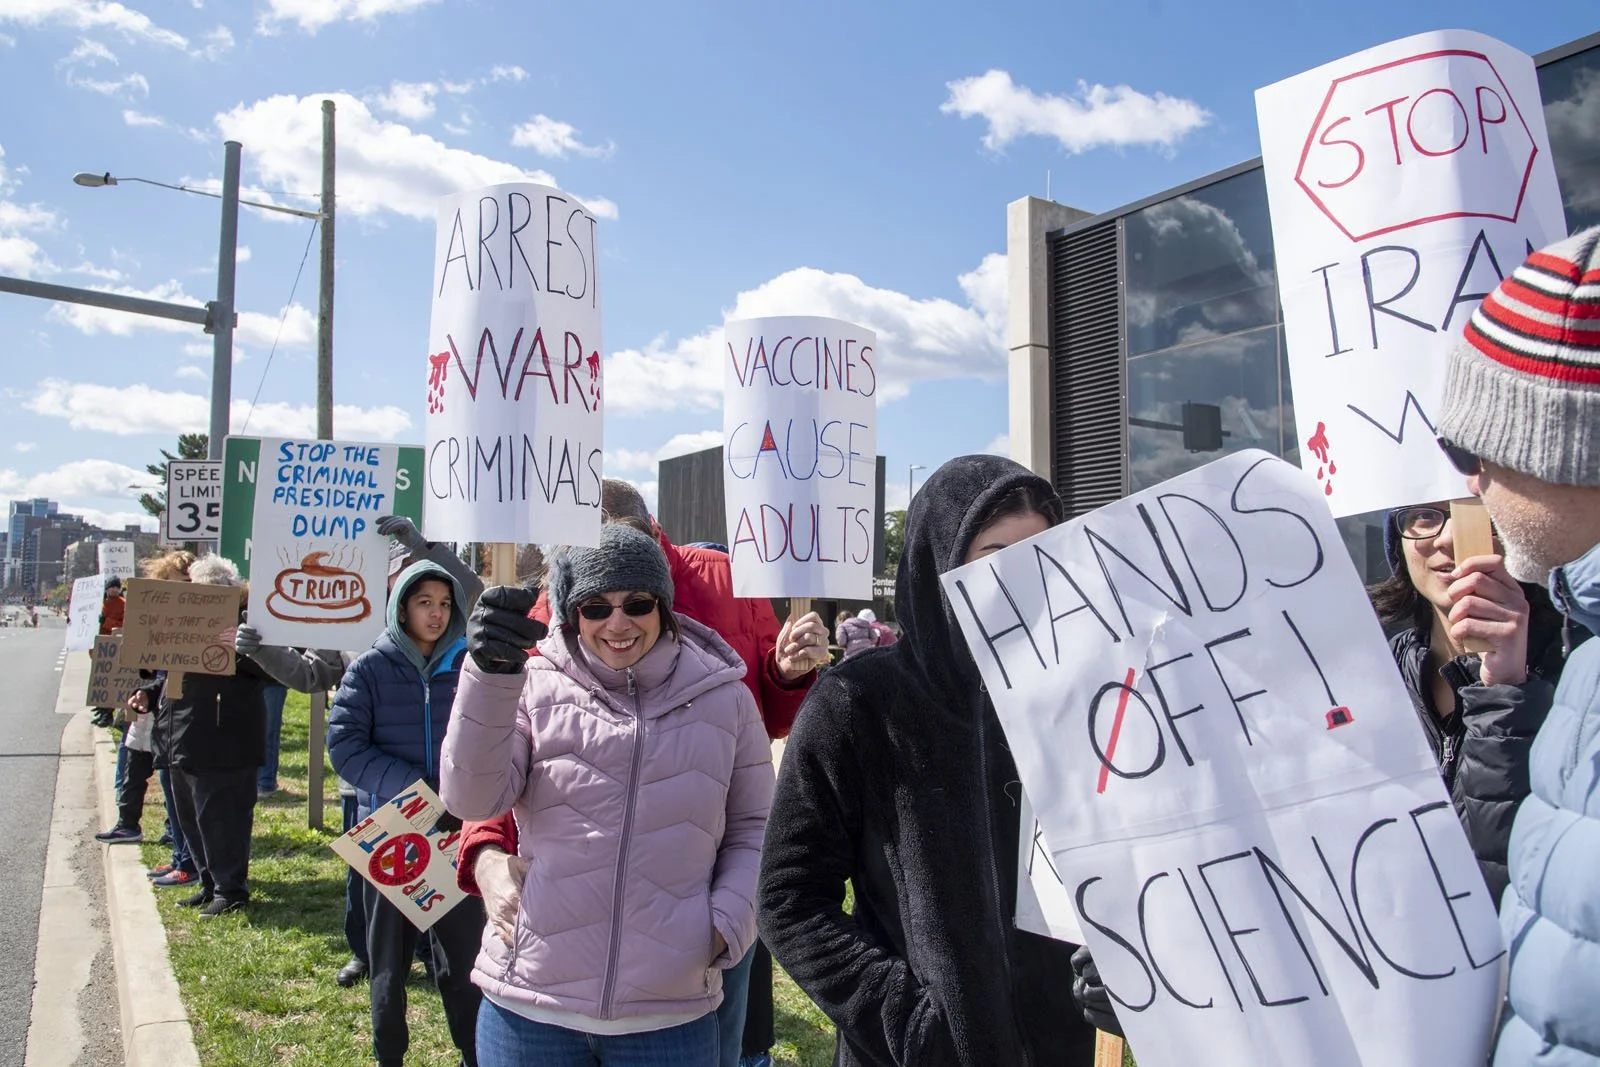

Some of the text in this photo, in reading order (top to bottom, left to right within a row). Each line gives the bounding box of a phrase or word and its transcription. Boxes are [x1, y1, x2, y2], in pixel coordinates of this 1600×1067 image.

[1317, 85, 1507, 188] STOP
[438, 192, 597, 309] ARREST
[1312, 229, 1536, 358] IRA
[447, 327, 590, 413] WAR
[727, 336, 876, 397] VACCINES
[277, 441, 380, 466] STOP THE
[728, 419, 868, 486] CAUSE
[174, 468, 220, 481] SPEE
[277, 464, 379, 489] CRIMINAL
[429, 433, 602, 508] CRIMINALS
[273, 486, 385, 511] PRESIDENT
[292, 514, 366, 540] DUMP
[731, 503, 870, 564] ADULTS
[956, 457, 1324, 689] HANDS
[140, 590, 172, 604] THE
[289, 579, 360, 600] TRUMP
[163, 615, 174, 627] IS
[177, 615, 205, 627] THAT
[207, 616, 225, 628] OF
[97, 642, 117, 658] NO
[139, 652, 200, 666] NO KINGS
[94, 660, 113, 674] NO
[93, 676, 109, 688] NO
[91, 689, 109, 703] NO
[347, 817, 389, 854] THE
[402, 878, 446, 912] STOP
[1075, 801, 1507, 1012] SCIENCE
